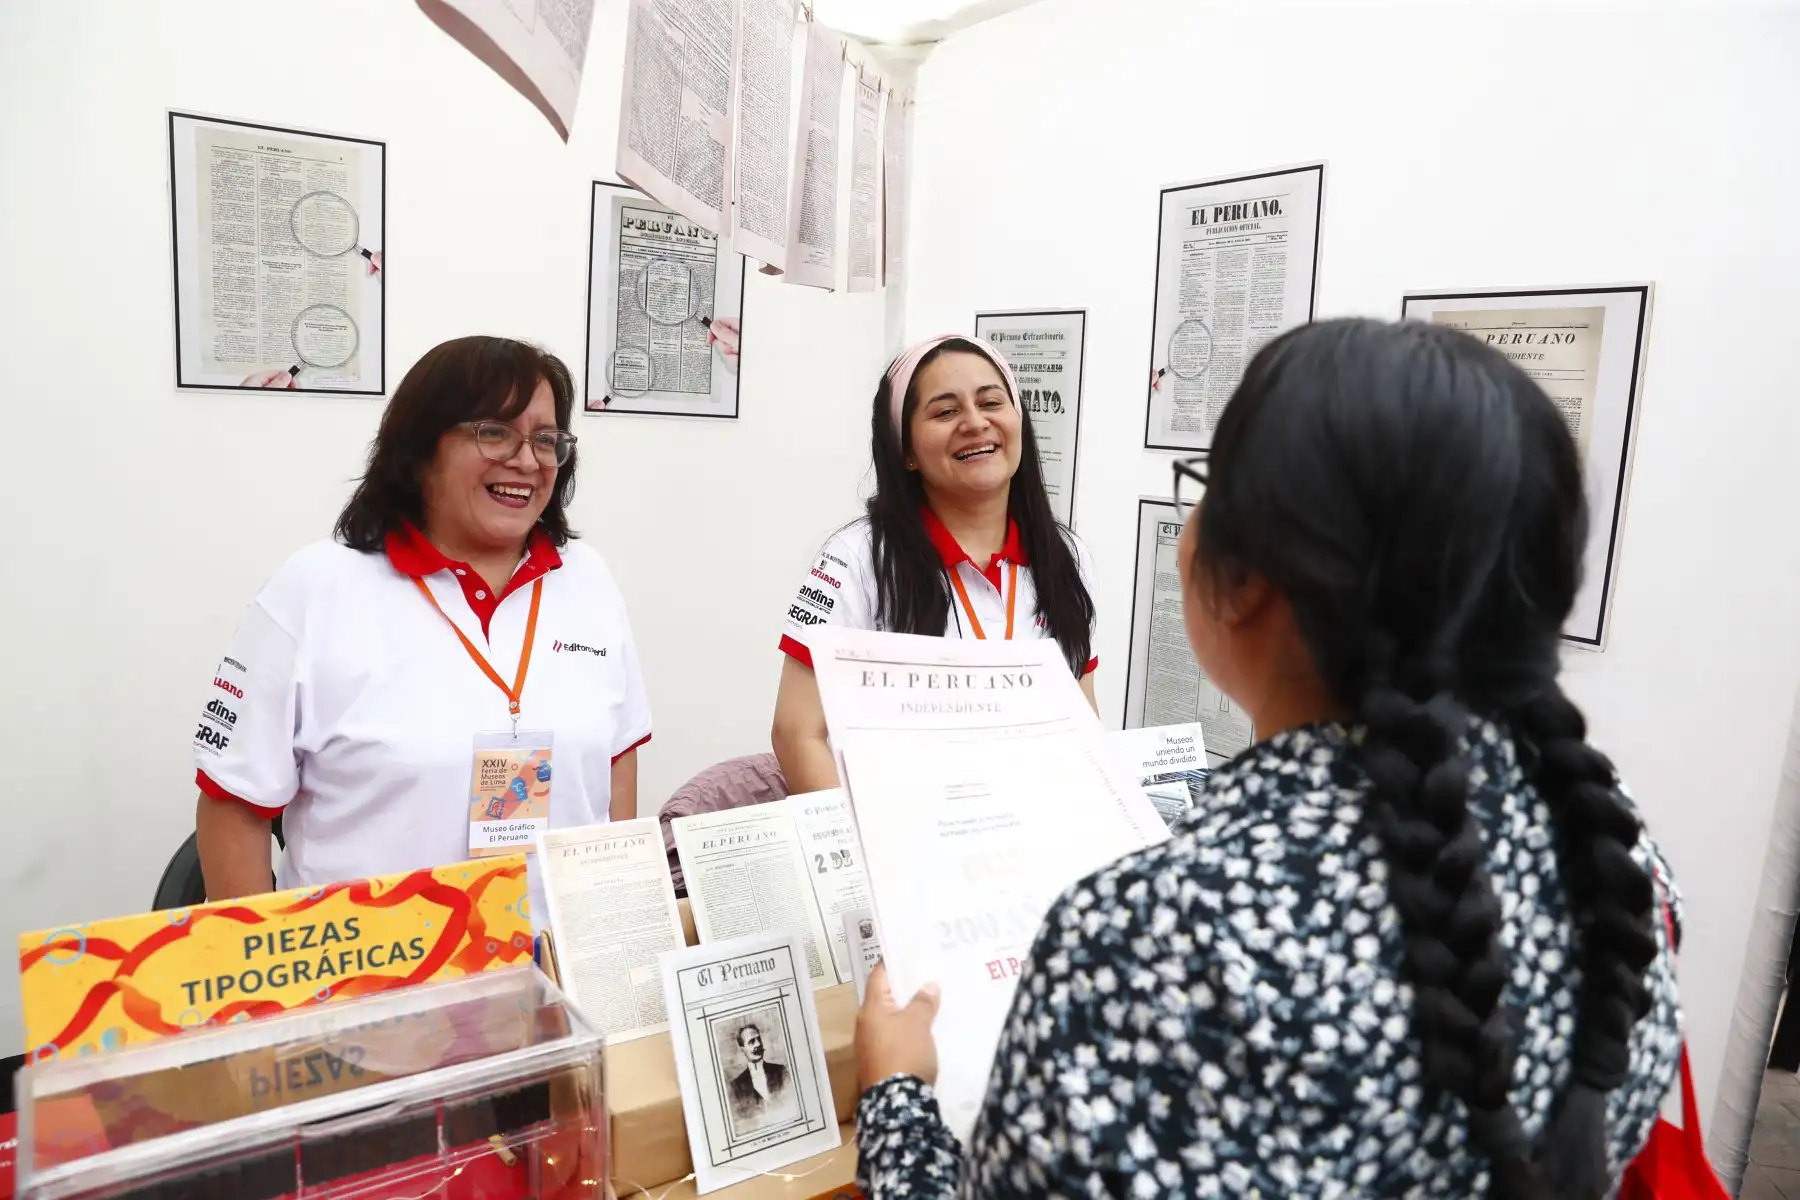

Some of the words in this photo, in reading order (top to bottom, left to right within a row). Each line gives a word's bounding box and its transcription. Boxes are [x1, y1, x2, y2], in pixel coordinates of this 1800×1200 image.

[1191, 208, 1207, 226] EL
[1213, 199, 1282, 223] PERUANO.
[990, 332, 998, 341] El
[1000, 332, 1021, 343] Peruano
[1486, 333, 1576, 345] PERUANO
[1019, 363, 1063, 373] ANIVERSARIO
[1163, 525, 1171, 534] El
[810, 567, 842, 589] eruano
[800, 585, 835, 609] andina
[860, 670, 895, 687] EL
[908, 672, 1034, 689] PERUANO
[1166, 736, 1194, 745] Museos
[1155, 746, 1185, 757] uniendo
[1185, 745, 1195, 753] un
[482, 759, 507, 768] XXIV
[1142, 758, 1168, 768] mundo
[1169, 754, 1197, 765] dividido
[509, 823, 536, 832] Gráfico
[489, 835, 496, 843] El
[498, 834, 529, 842] Peruano
[702, 839, 717, 849] EL
[719, 831, 777, 846] PERUANO
[563, 847, 580, 857] EL
[814, 853, 828, 874] 2
[243, 917, 360, 960] PIEZAS
[181, 937, 425, 1005] TIPOGRÁFICAS
[697, 967, 713, 987] El
[717, 957, 776, 981] Peruano
